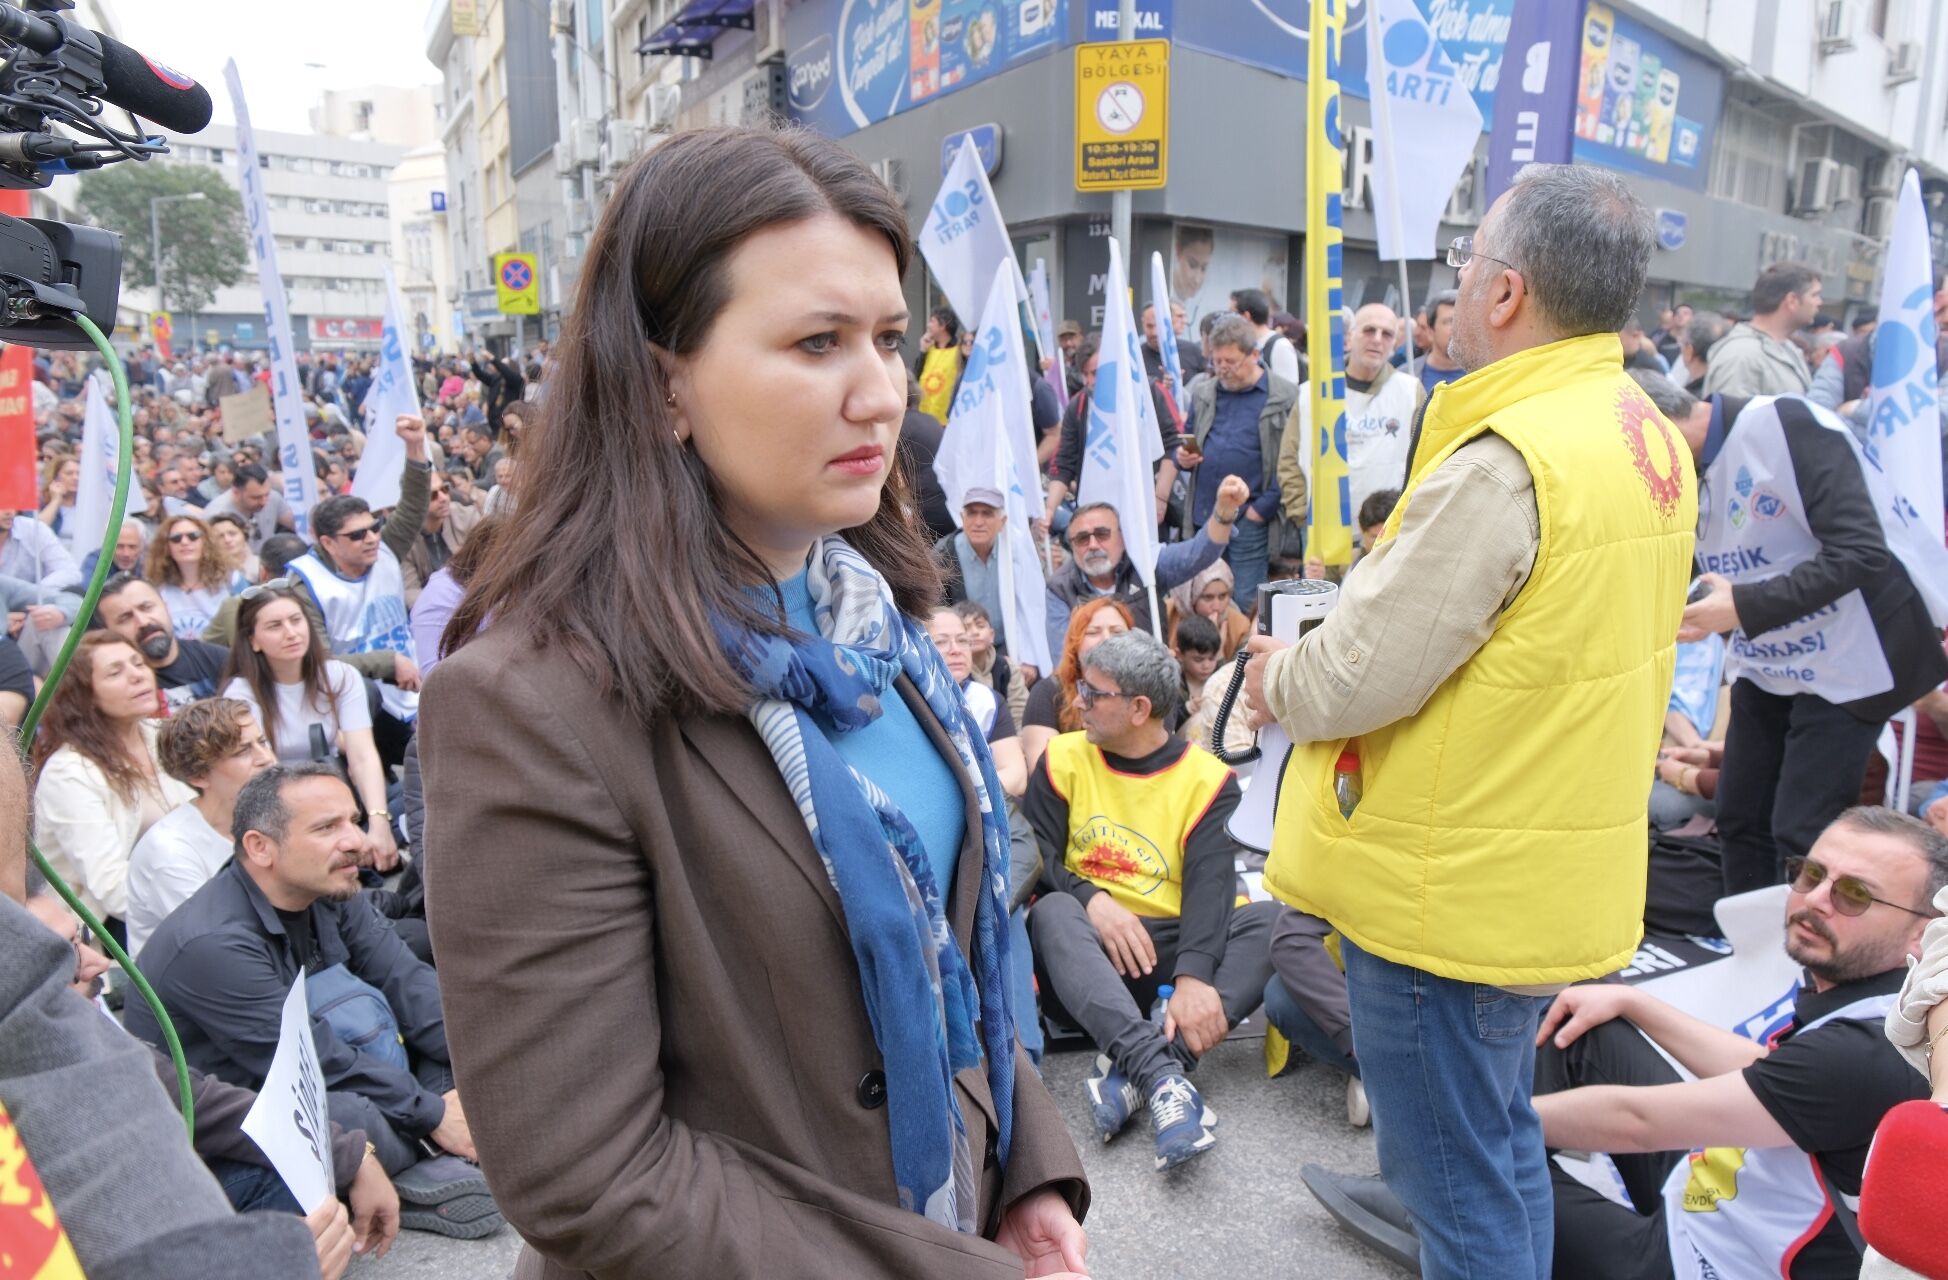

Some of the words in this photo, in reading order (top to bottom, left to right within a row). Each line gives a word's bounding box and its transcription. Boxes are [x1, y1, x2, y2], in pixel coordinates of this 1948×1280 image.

[1095, 10, 1163, 29] MEKAL
[1096, 45, 1148, 60] YAYA
[1386, 70, 1453, 106] ARTİ
